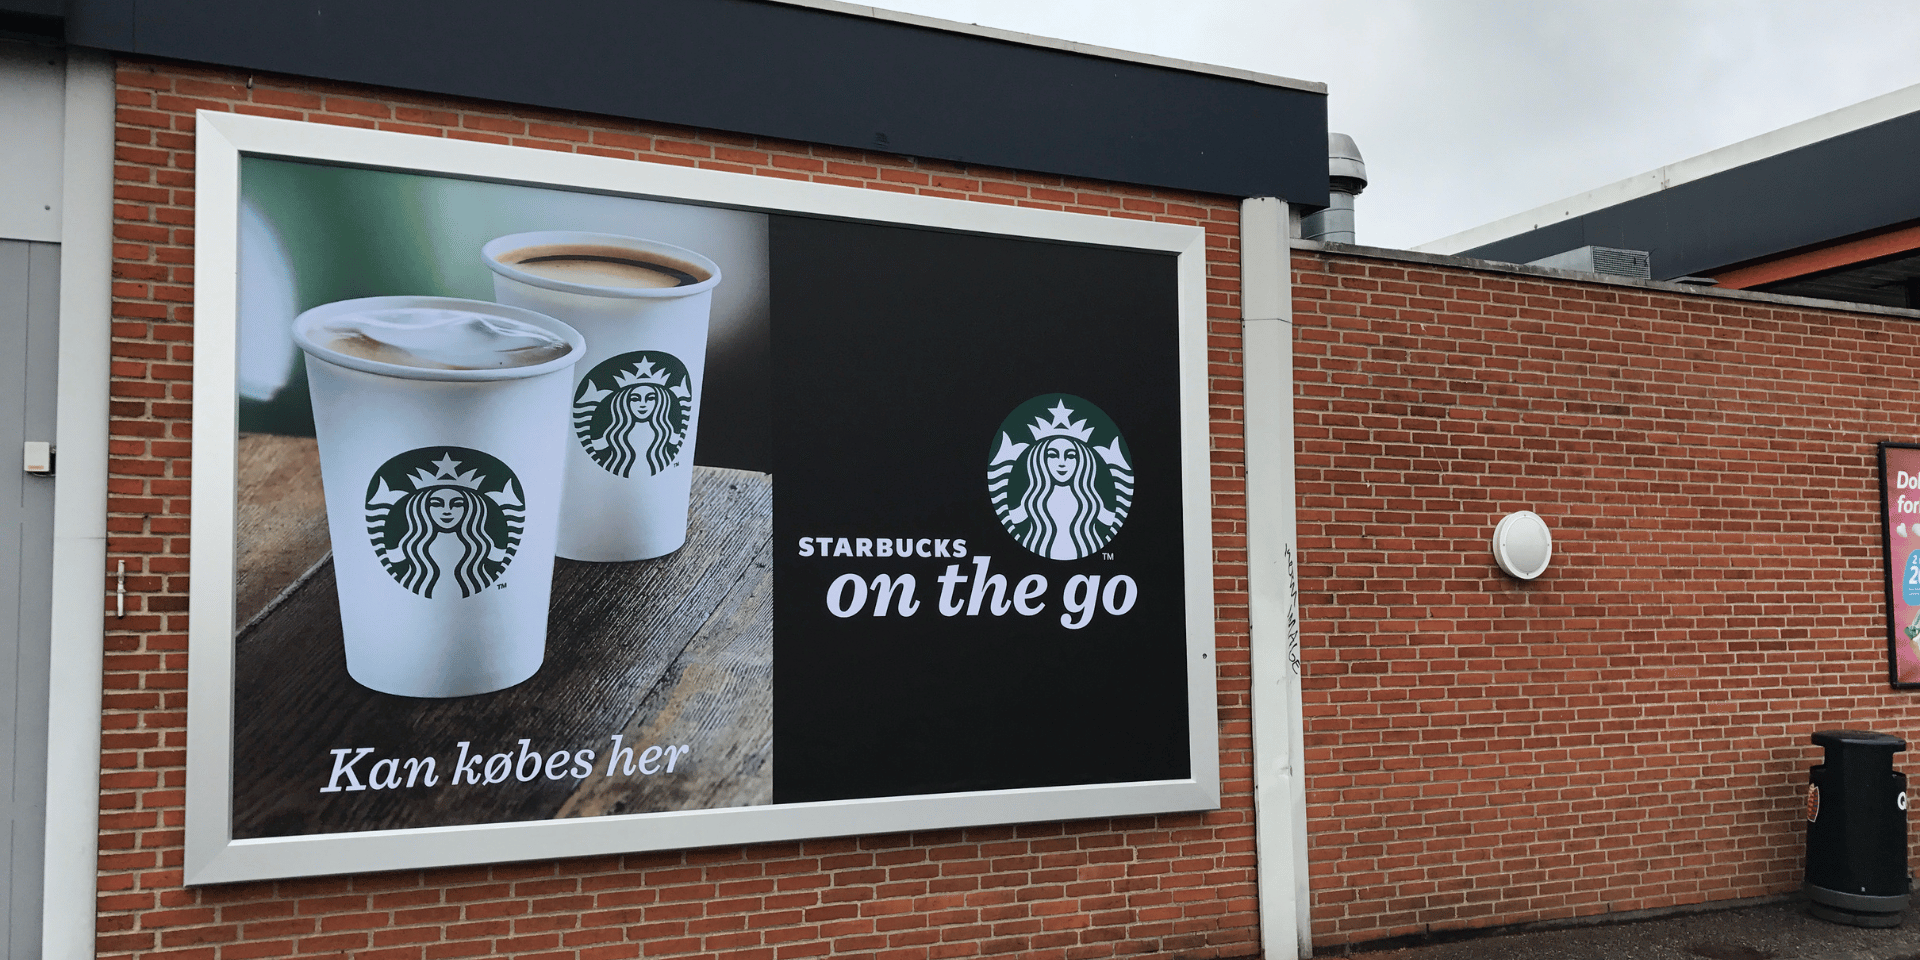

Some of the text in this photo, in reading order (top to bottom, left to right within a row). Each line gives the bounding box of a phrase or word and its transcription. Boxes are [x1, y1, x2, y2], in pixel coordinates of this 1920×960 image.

[1897, 494, 1920, 513] for
[798, 536, 967, 558] STARBUCKS
[1102, 552, 1114, 561] TM
[826, 555, 1138, 630] on the go
[319, 734, 690, 793] Kan købes her
